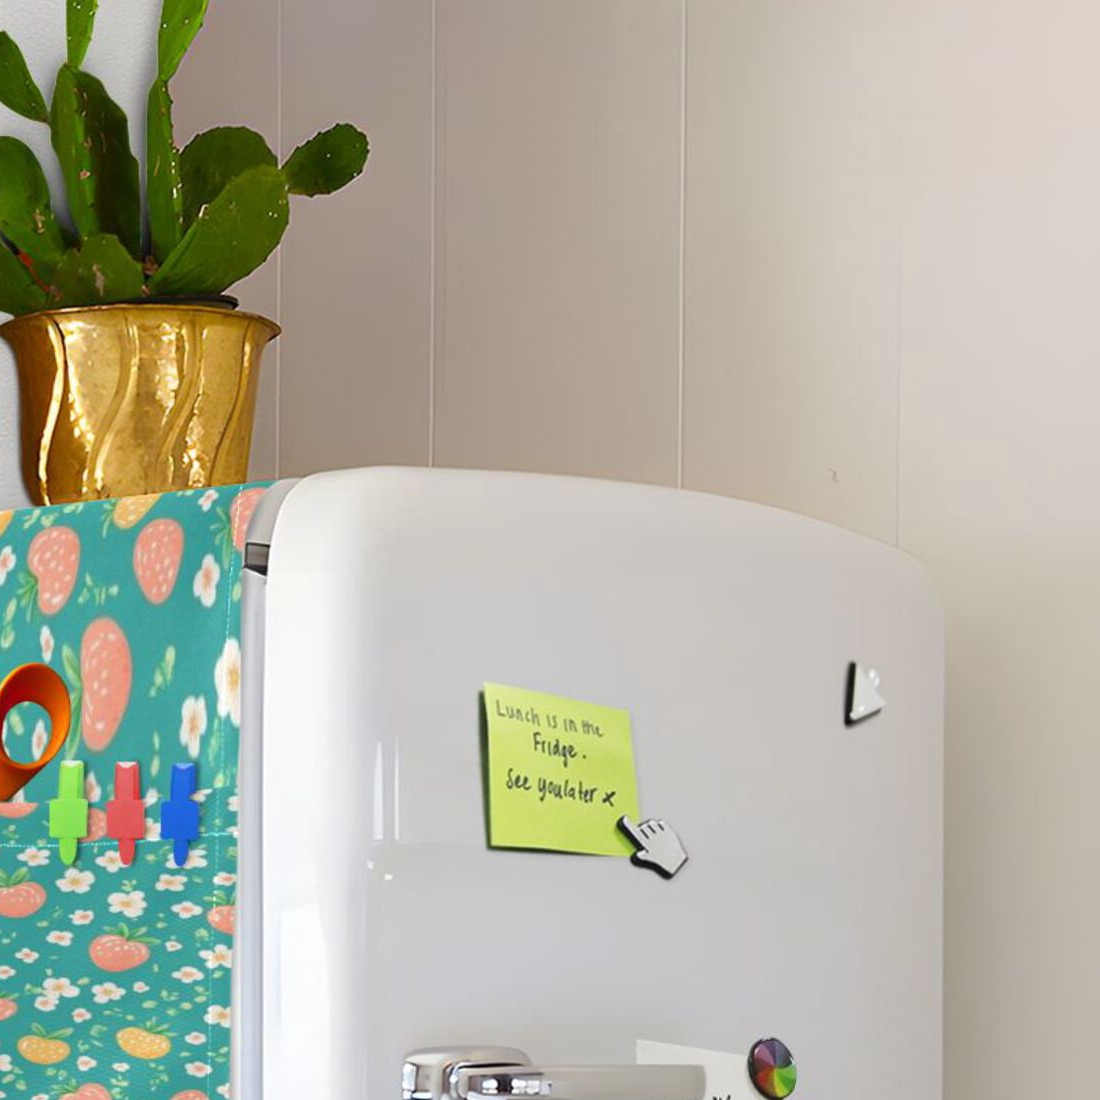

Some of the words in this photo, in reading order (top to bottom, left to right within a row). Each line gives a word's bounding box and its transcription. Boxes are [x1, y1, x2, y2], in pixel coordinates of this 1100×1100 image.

[496, 700, 540, 727] Lunch
[546, 714, 557, 728] is
[563, 719, 578, 733] in
[582, 720, 604, 737] the
[506, 768, 532, 791] See
